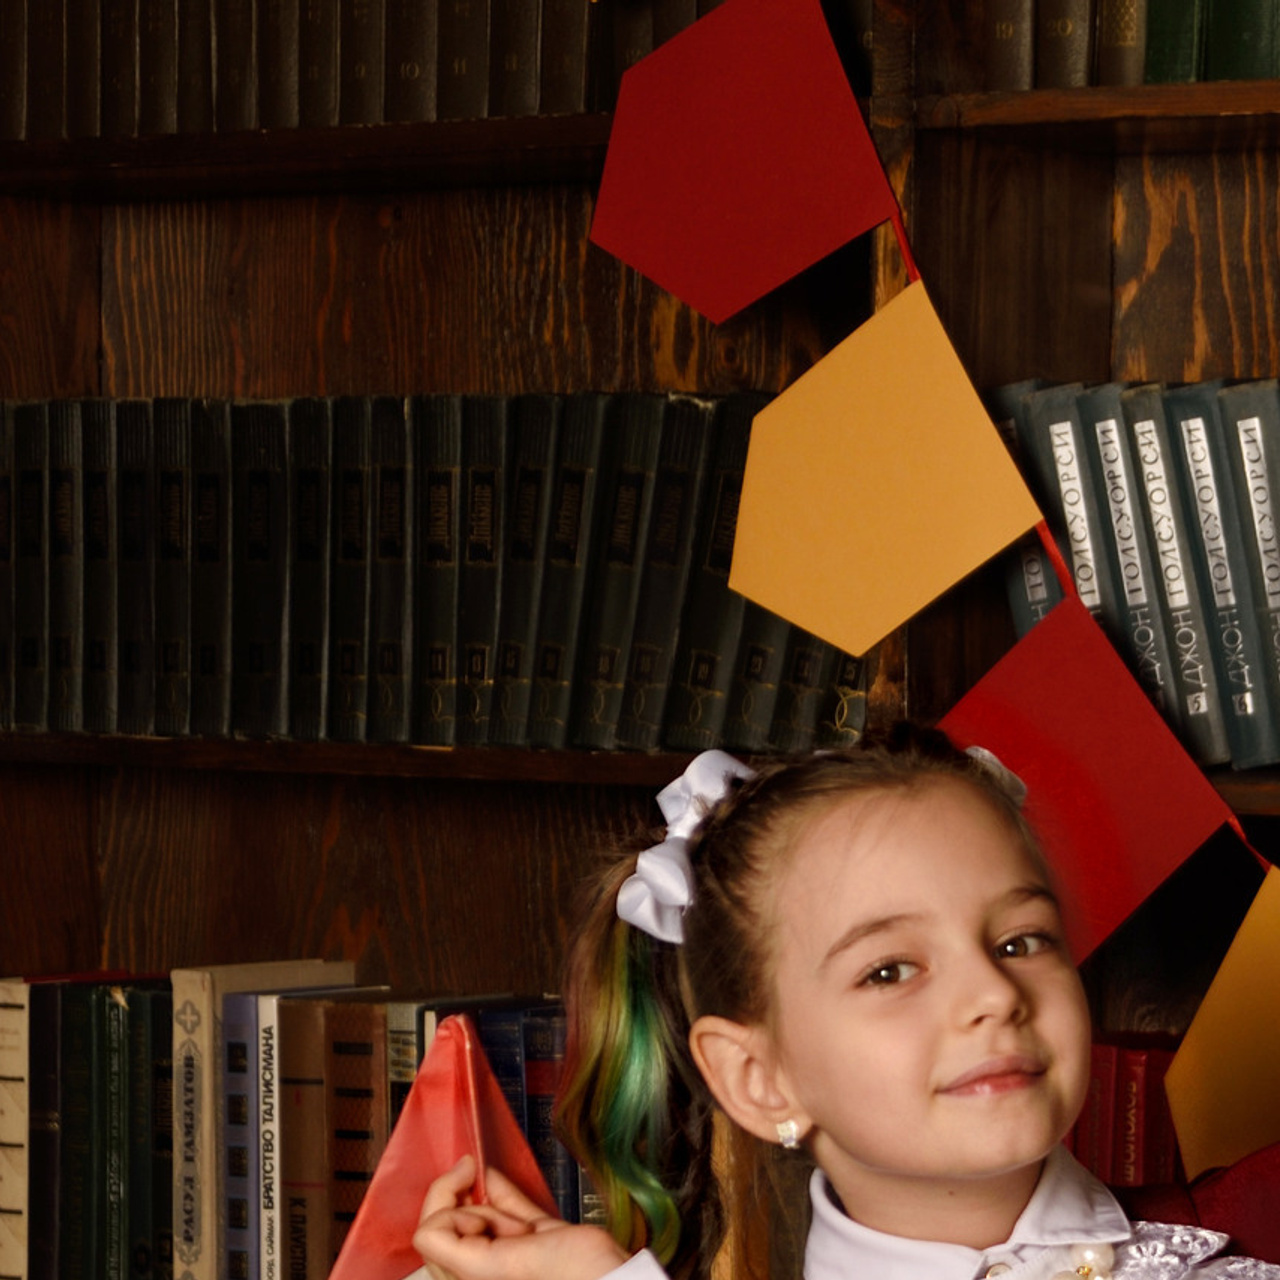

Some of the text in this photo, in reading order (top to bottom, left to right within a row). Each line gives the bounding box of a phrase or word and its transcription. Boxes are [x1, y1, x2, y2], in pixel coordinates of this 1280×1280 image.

[1053, 430, 1097, 597] ГОЛСУОРСИ
[1100, 428, 1142, 594] ГОЛСУОРСИ
[1138, 428, 1207, 687] ДЖОН ГОЛСУОРСИ
[1187, 426, 1253, 688] ДЖОН ГОЛСУОРСИ
[1192, 694, 1203, 712] 5
[182, 1054, 196, 1244] РАСУЛ ГАМЗАТОВ
[262, 1026, 274, 1123] ТАЛИСМАНА
[262, 1130, 275, 1210] БРАТСТВО
